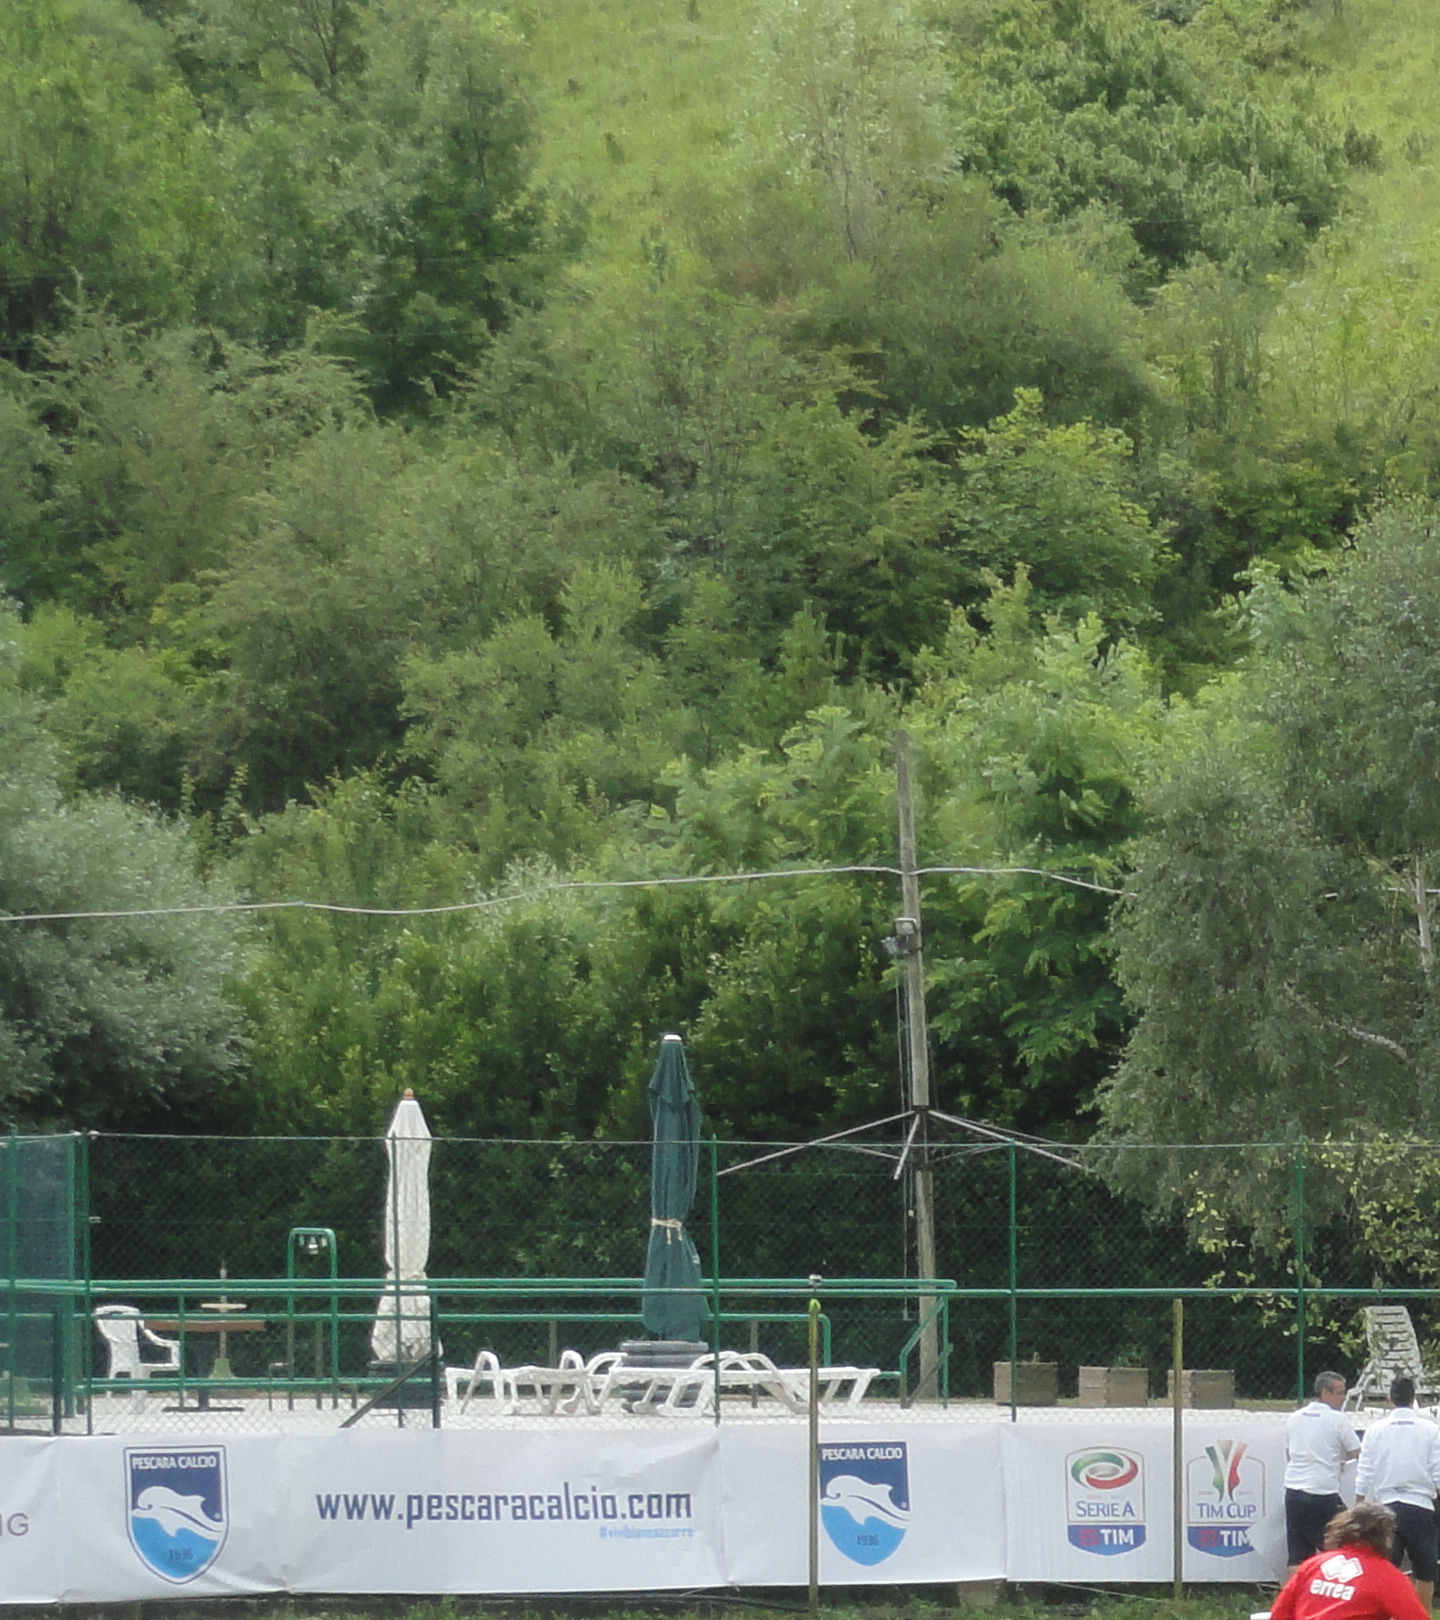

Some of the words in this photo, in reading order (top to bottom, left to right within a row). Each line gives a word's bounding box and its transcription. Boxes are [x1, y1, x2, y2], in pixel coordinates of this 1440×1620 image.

[822, 1448, 866, 1461] PESCARA
[866, 1447, 903, 1460] CALCIO
[132, 1456, 176, 1470] PESCARA
[178, 1456, 217, 1469] CALCIO
[316, 1481, 692, 1530] www.pescaracalcio.com
[1076, 1501, 1121, 1518] SERIE
[1122, 1502, 1136, 1517] A
[1196, 1503, 1224, 1519] TIM
[1226, 1503, 1257, 1519] CUP
[0, 1512, 29, 1537] G
[1100, 1529, 1134, 1546] TIM
[1309, 1579, 1356, 1601] errea
